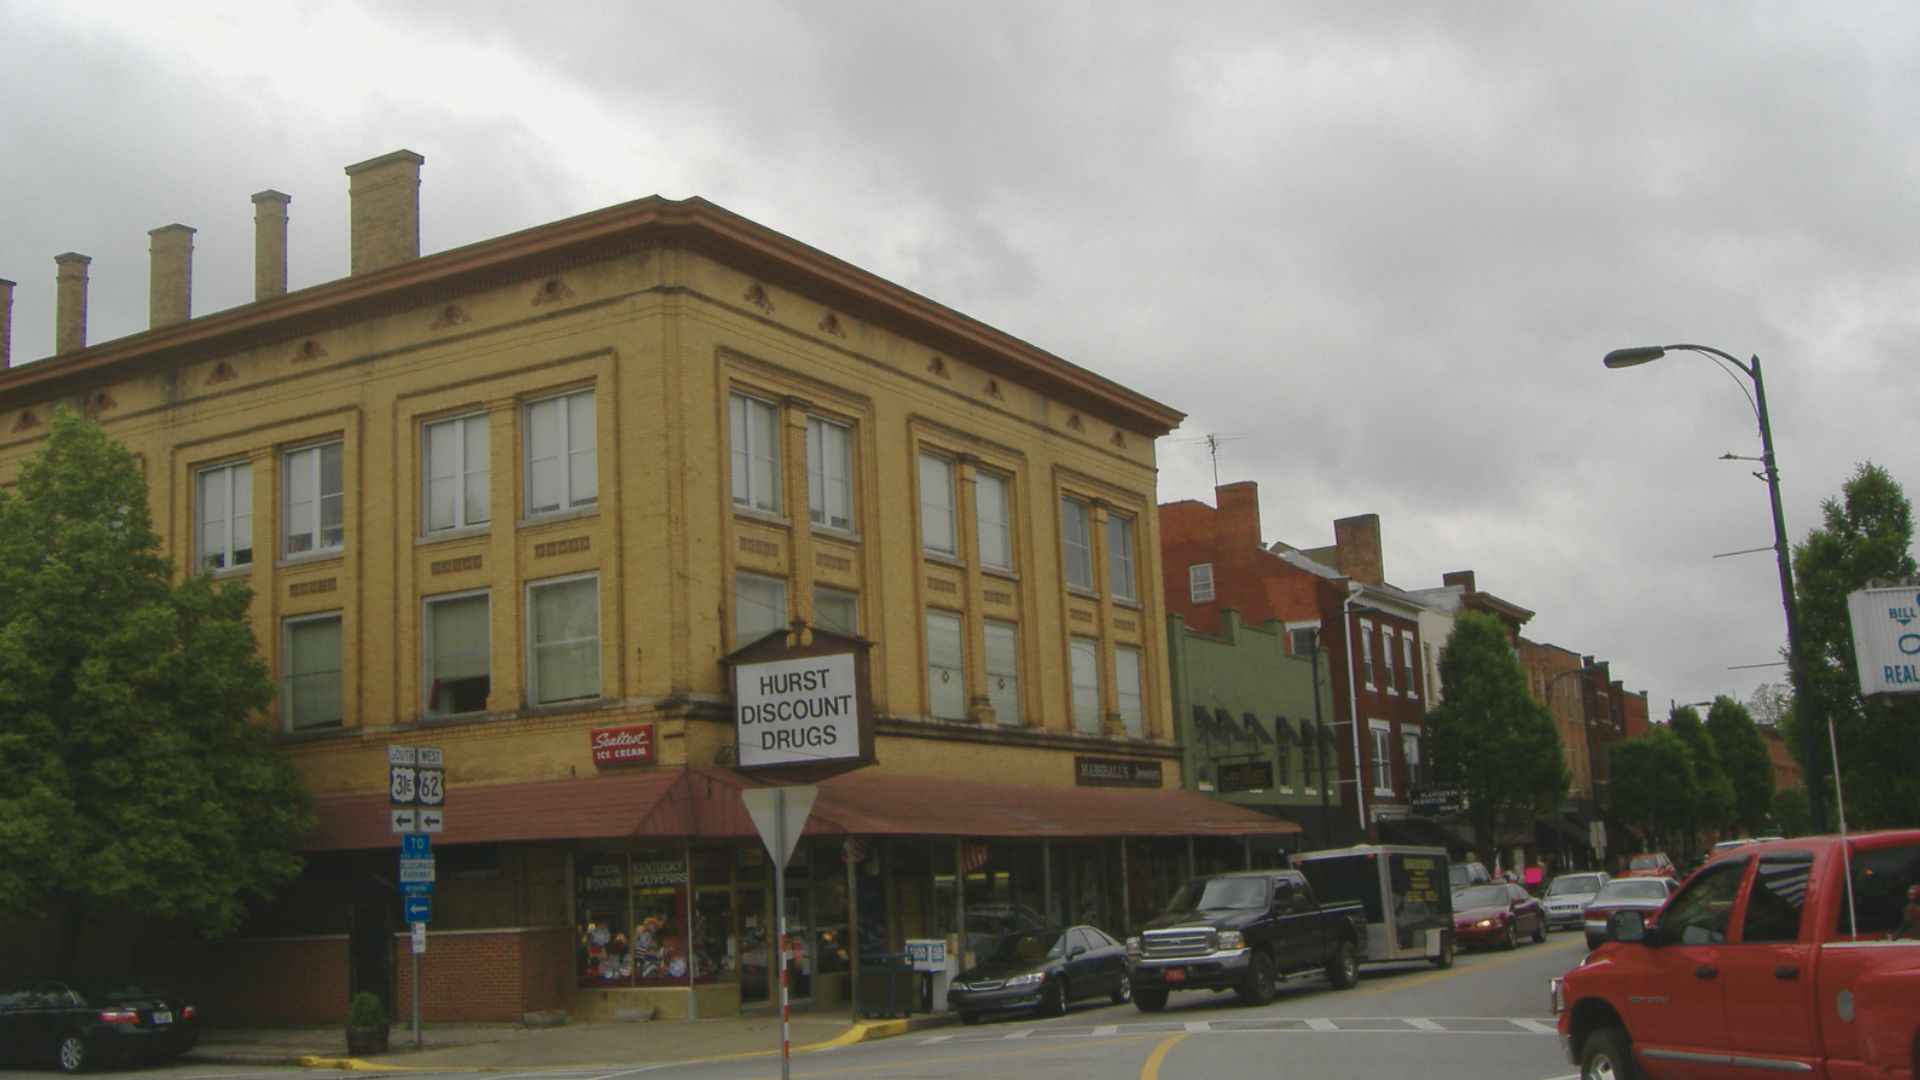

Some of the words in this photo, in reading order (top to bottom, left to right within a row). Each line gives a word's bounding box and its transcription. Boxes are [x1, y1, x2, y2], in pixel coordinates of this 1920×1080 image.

[1888, 607, 1917, 619] BILL
[1884, 664, 1920, 684] REAL
[760, 669, 830, 696] HURST
[741, 695, 852, 725] DISCOUNT
[592, 730, 649, 749] Sealtest
[762, 725, 837, 750] DRUGS
[391, 750, 415, 760] SOUTH
[421, 750, 440, 762] WEST
[596, 750, 611, 760] ICE
[614, 747, 646, 758] CREAM
[421, 776, 439, 797] 62
[411, 838, 424, 849] TO
[592, 864, 621, 876] SODA
[632, 860, 683, 873] KENTUCKY
[632, 872, 687, 887] SOUVENIRS
